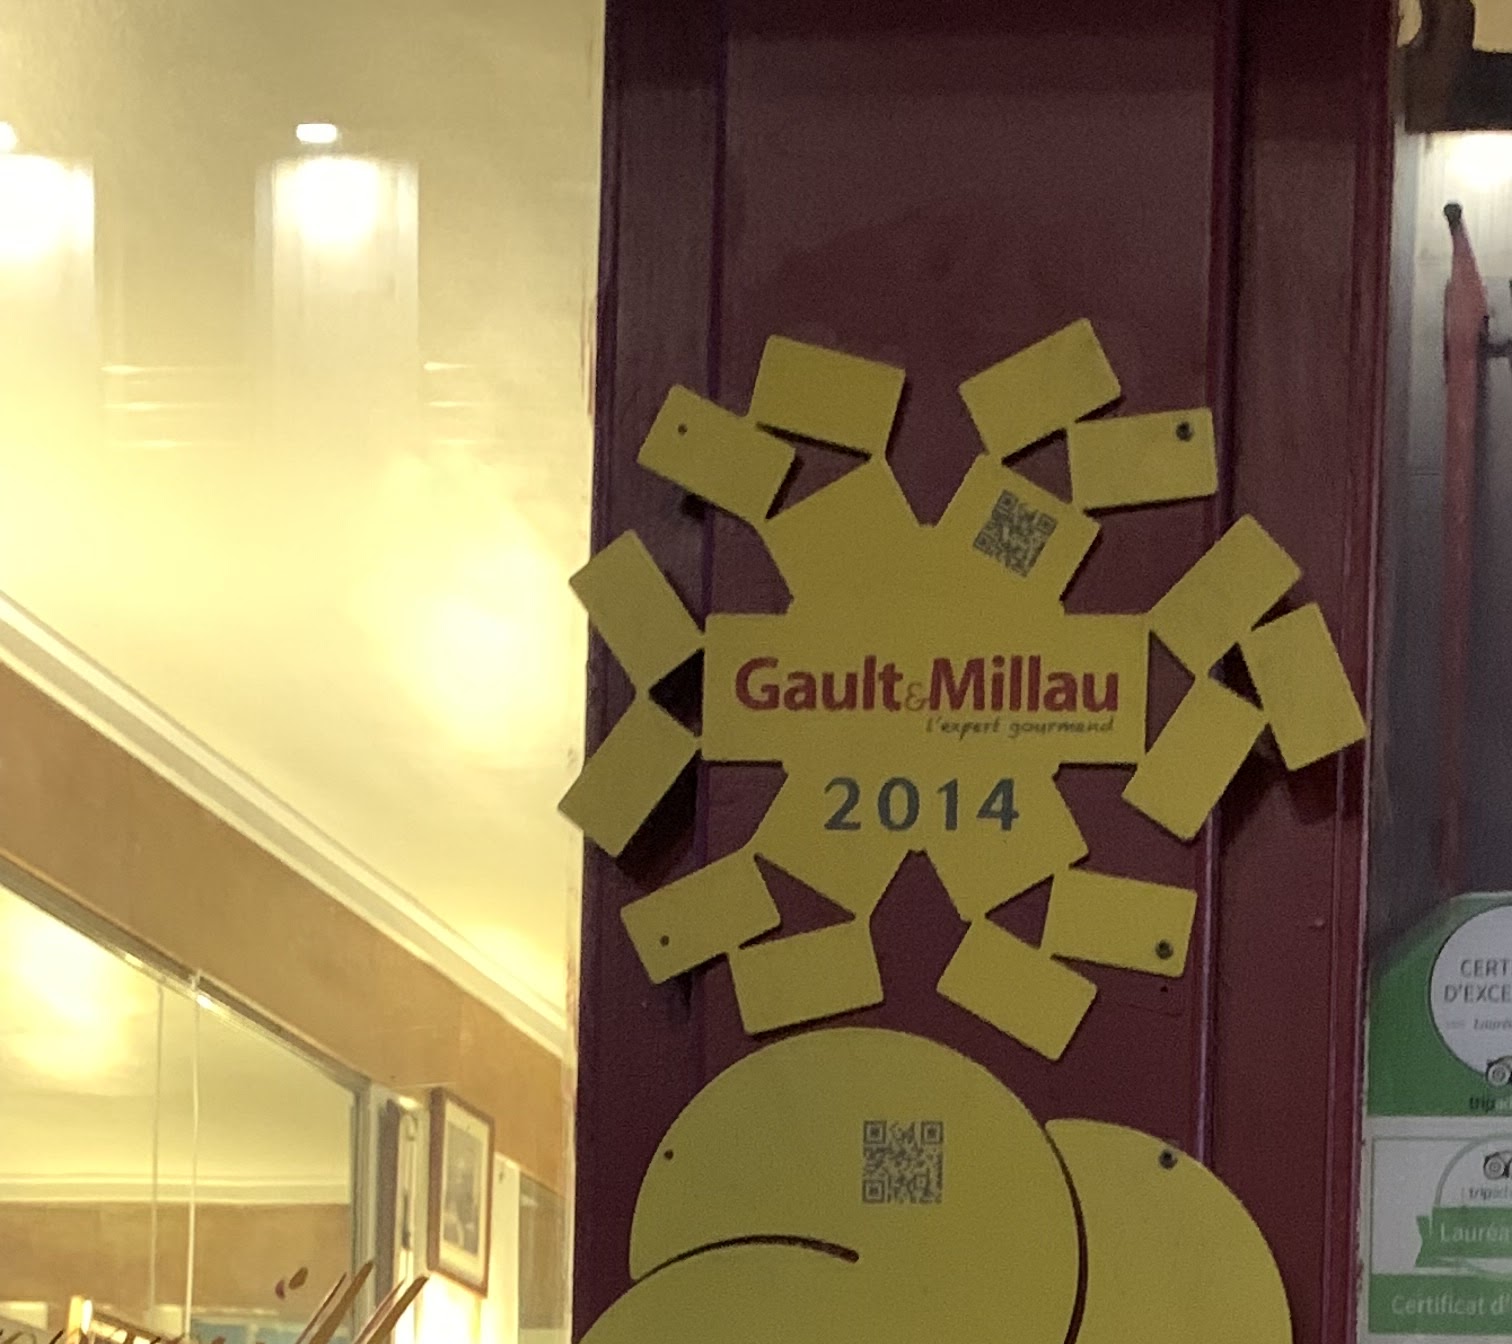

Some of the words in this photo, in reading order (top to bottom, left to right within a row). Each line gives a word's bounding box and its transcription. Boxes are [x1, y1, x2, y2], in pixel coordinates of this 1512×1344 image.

[735, 654, 1120, 715] Gault&Millau
[823, 776, 1021, 833] 2014
[1391, 1293, 1483, 1316] Certificat
